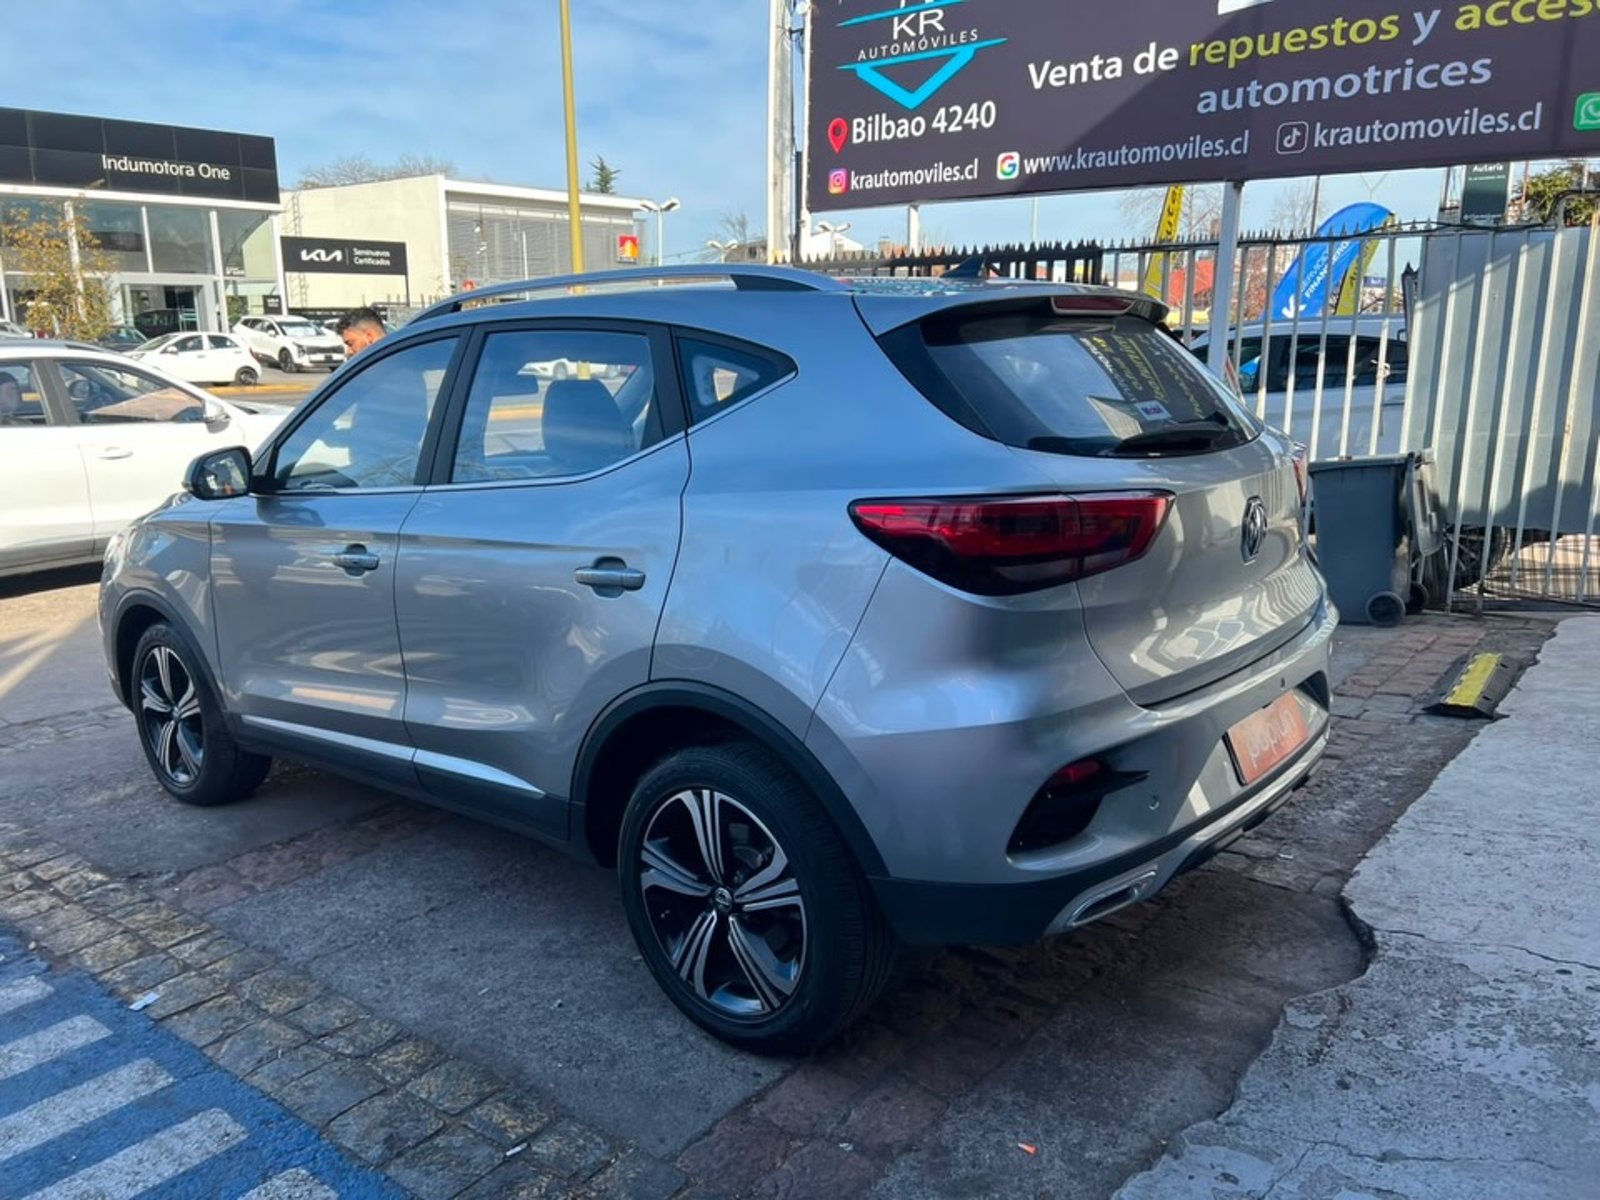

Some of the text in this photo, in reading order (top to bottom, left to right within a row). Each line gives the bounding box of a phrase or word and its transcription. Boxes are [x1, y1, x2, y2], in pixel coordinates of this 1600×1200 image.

[857, 27, 979, 62] AUTOMÓVILES
[892, 7, 945, 41] KR
[1028, 0, 1600, 90] Venta de repuestos y acces
[1196, 56, 1493, 114] automotrices
[851, 100, 997, 144] Bilbao 4240
[1313, 101, 1543, 148] krautomoviles.cl
[101, 153, 231, 181] Indumotora One
[1023, 129, 1250, 175] www.krautomoviles.cl
[850, 158, 979, 191] krautomoviles.cl
